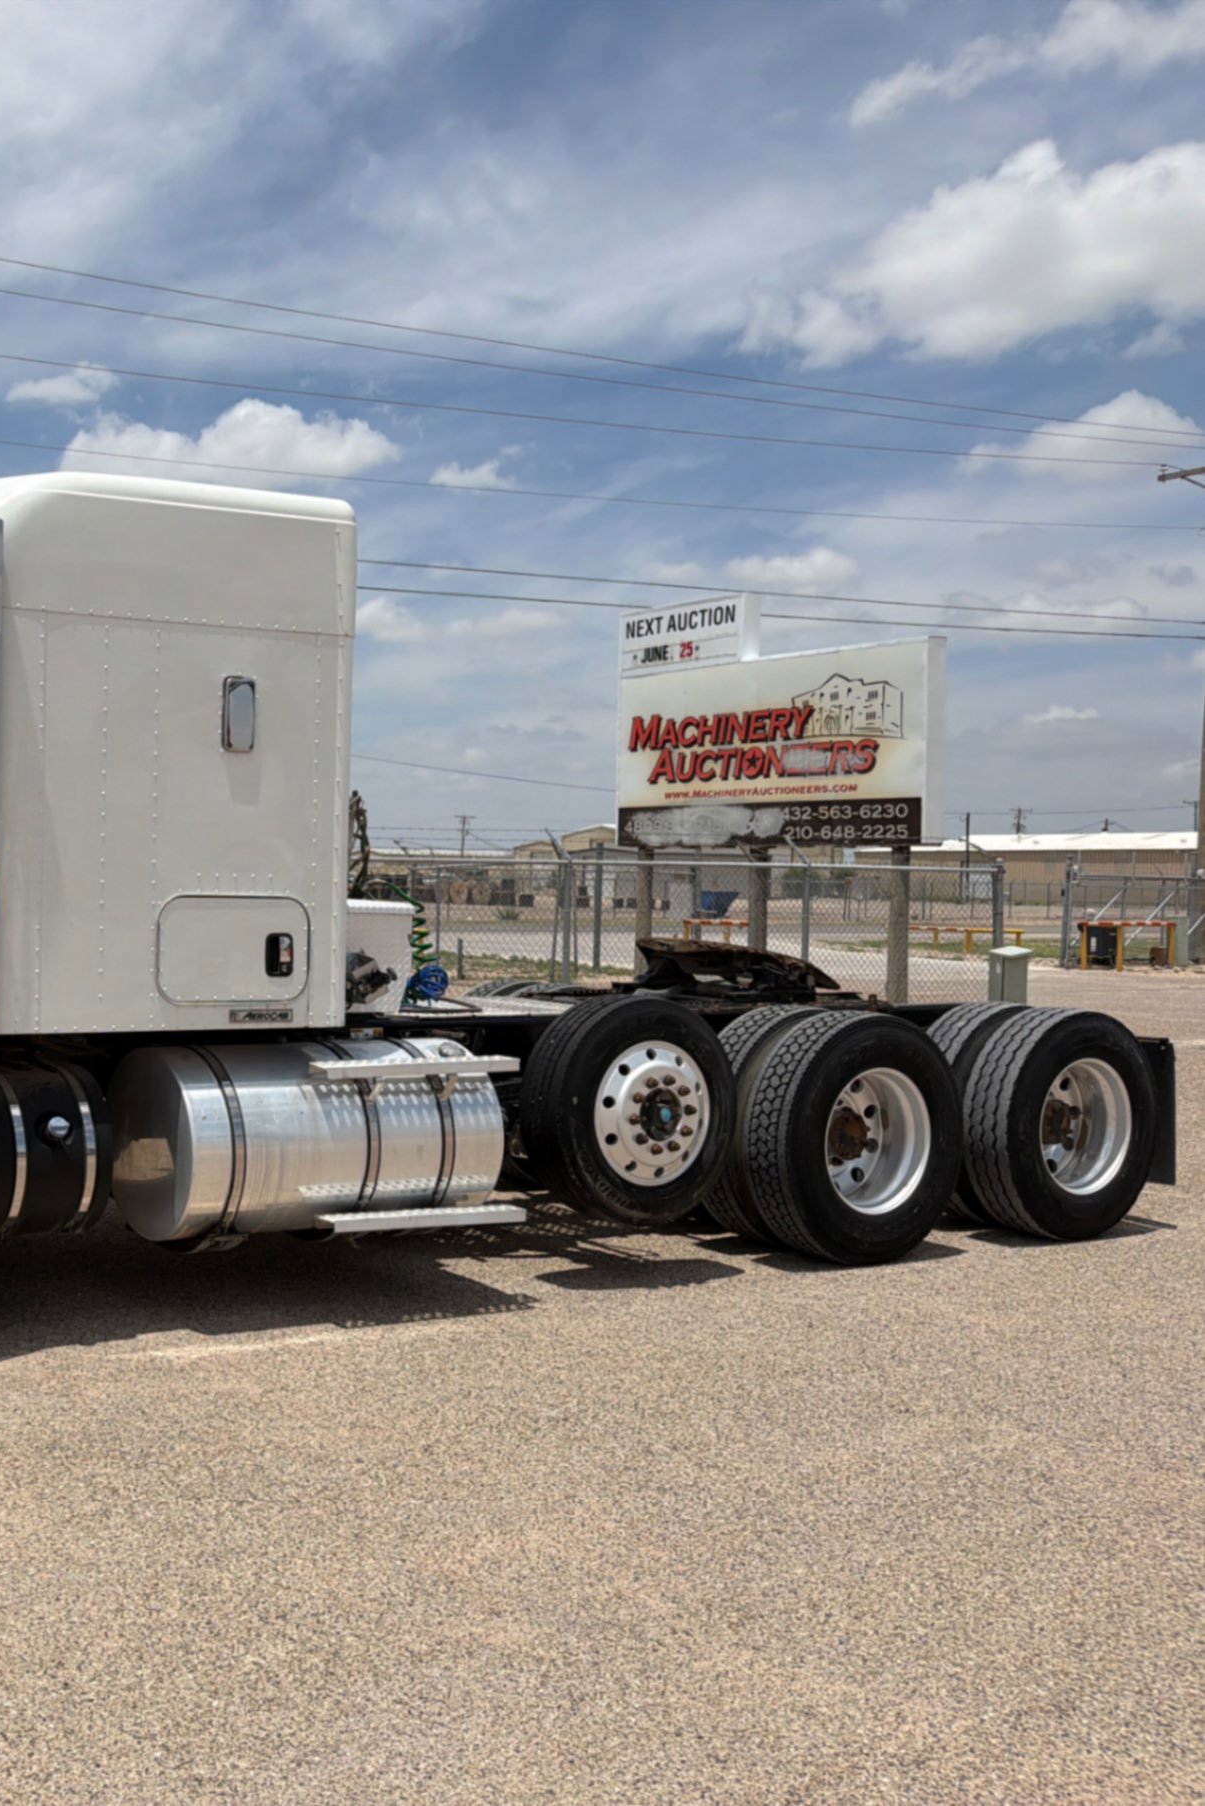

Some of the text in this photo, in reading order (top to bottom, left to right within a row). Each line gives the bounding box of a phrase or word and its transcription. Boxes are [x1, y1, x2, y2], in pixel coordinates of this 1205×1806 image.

[625, 604, 736, 639] NEXT AUCTION
[679, 641, 693, 659] 25
[629, 705, 815, 751] MACHINERY
[782, 803, 909, 821] 432-563-6230
[785, 824, 909, 840] 210-648-2225
